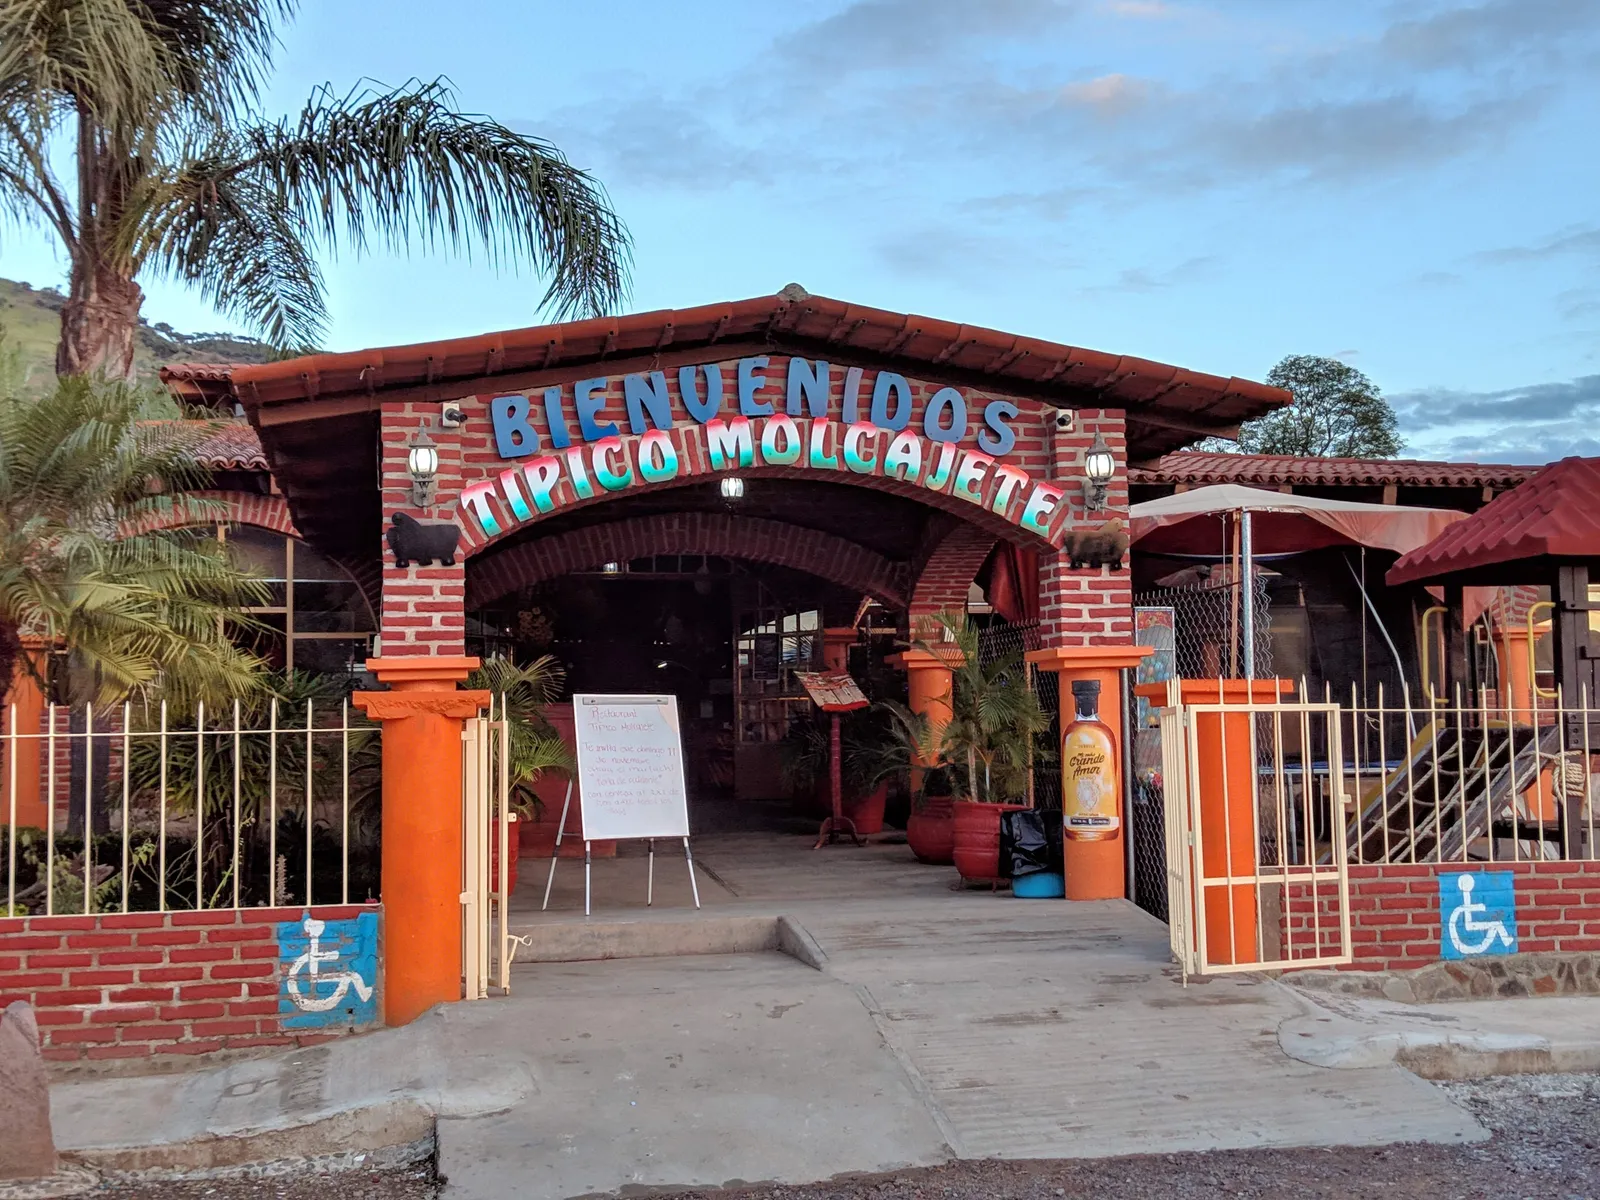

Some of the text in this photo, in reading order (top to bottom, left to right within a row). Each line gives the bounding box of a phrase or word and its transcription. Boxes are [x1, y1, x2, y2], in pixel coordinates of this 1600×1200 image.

[491, 356, 1020, 459] BIENVENIDOS
[461, 414, 1064, 537] TIPICO MOLCAJETE
[1069, 753, 1105, 767] Grande
[1072, 765, 1101, 780] Amor
